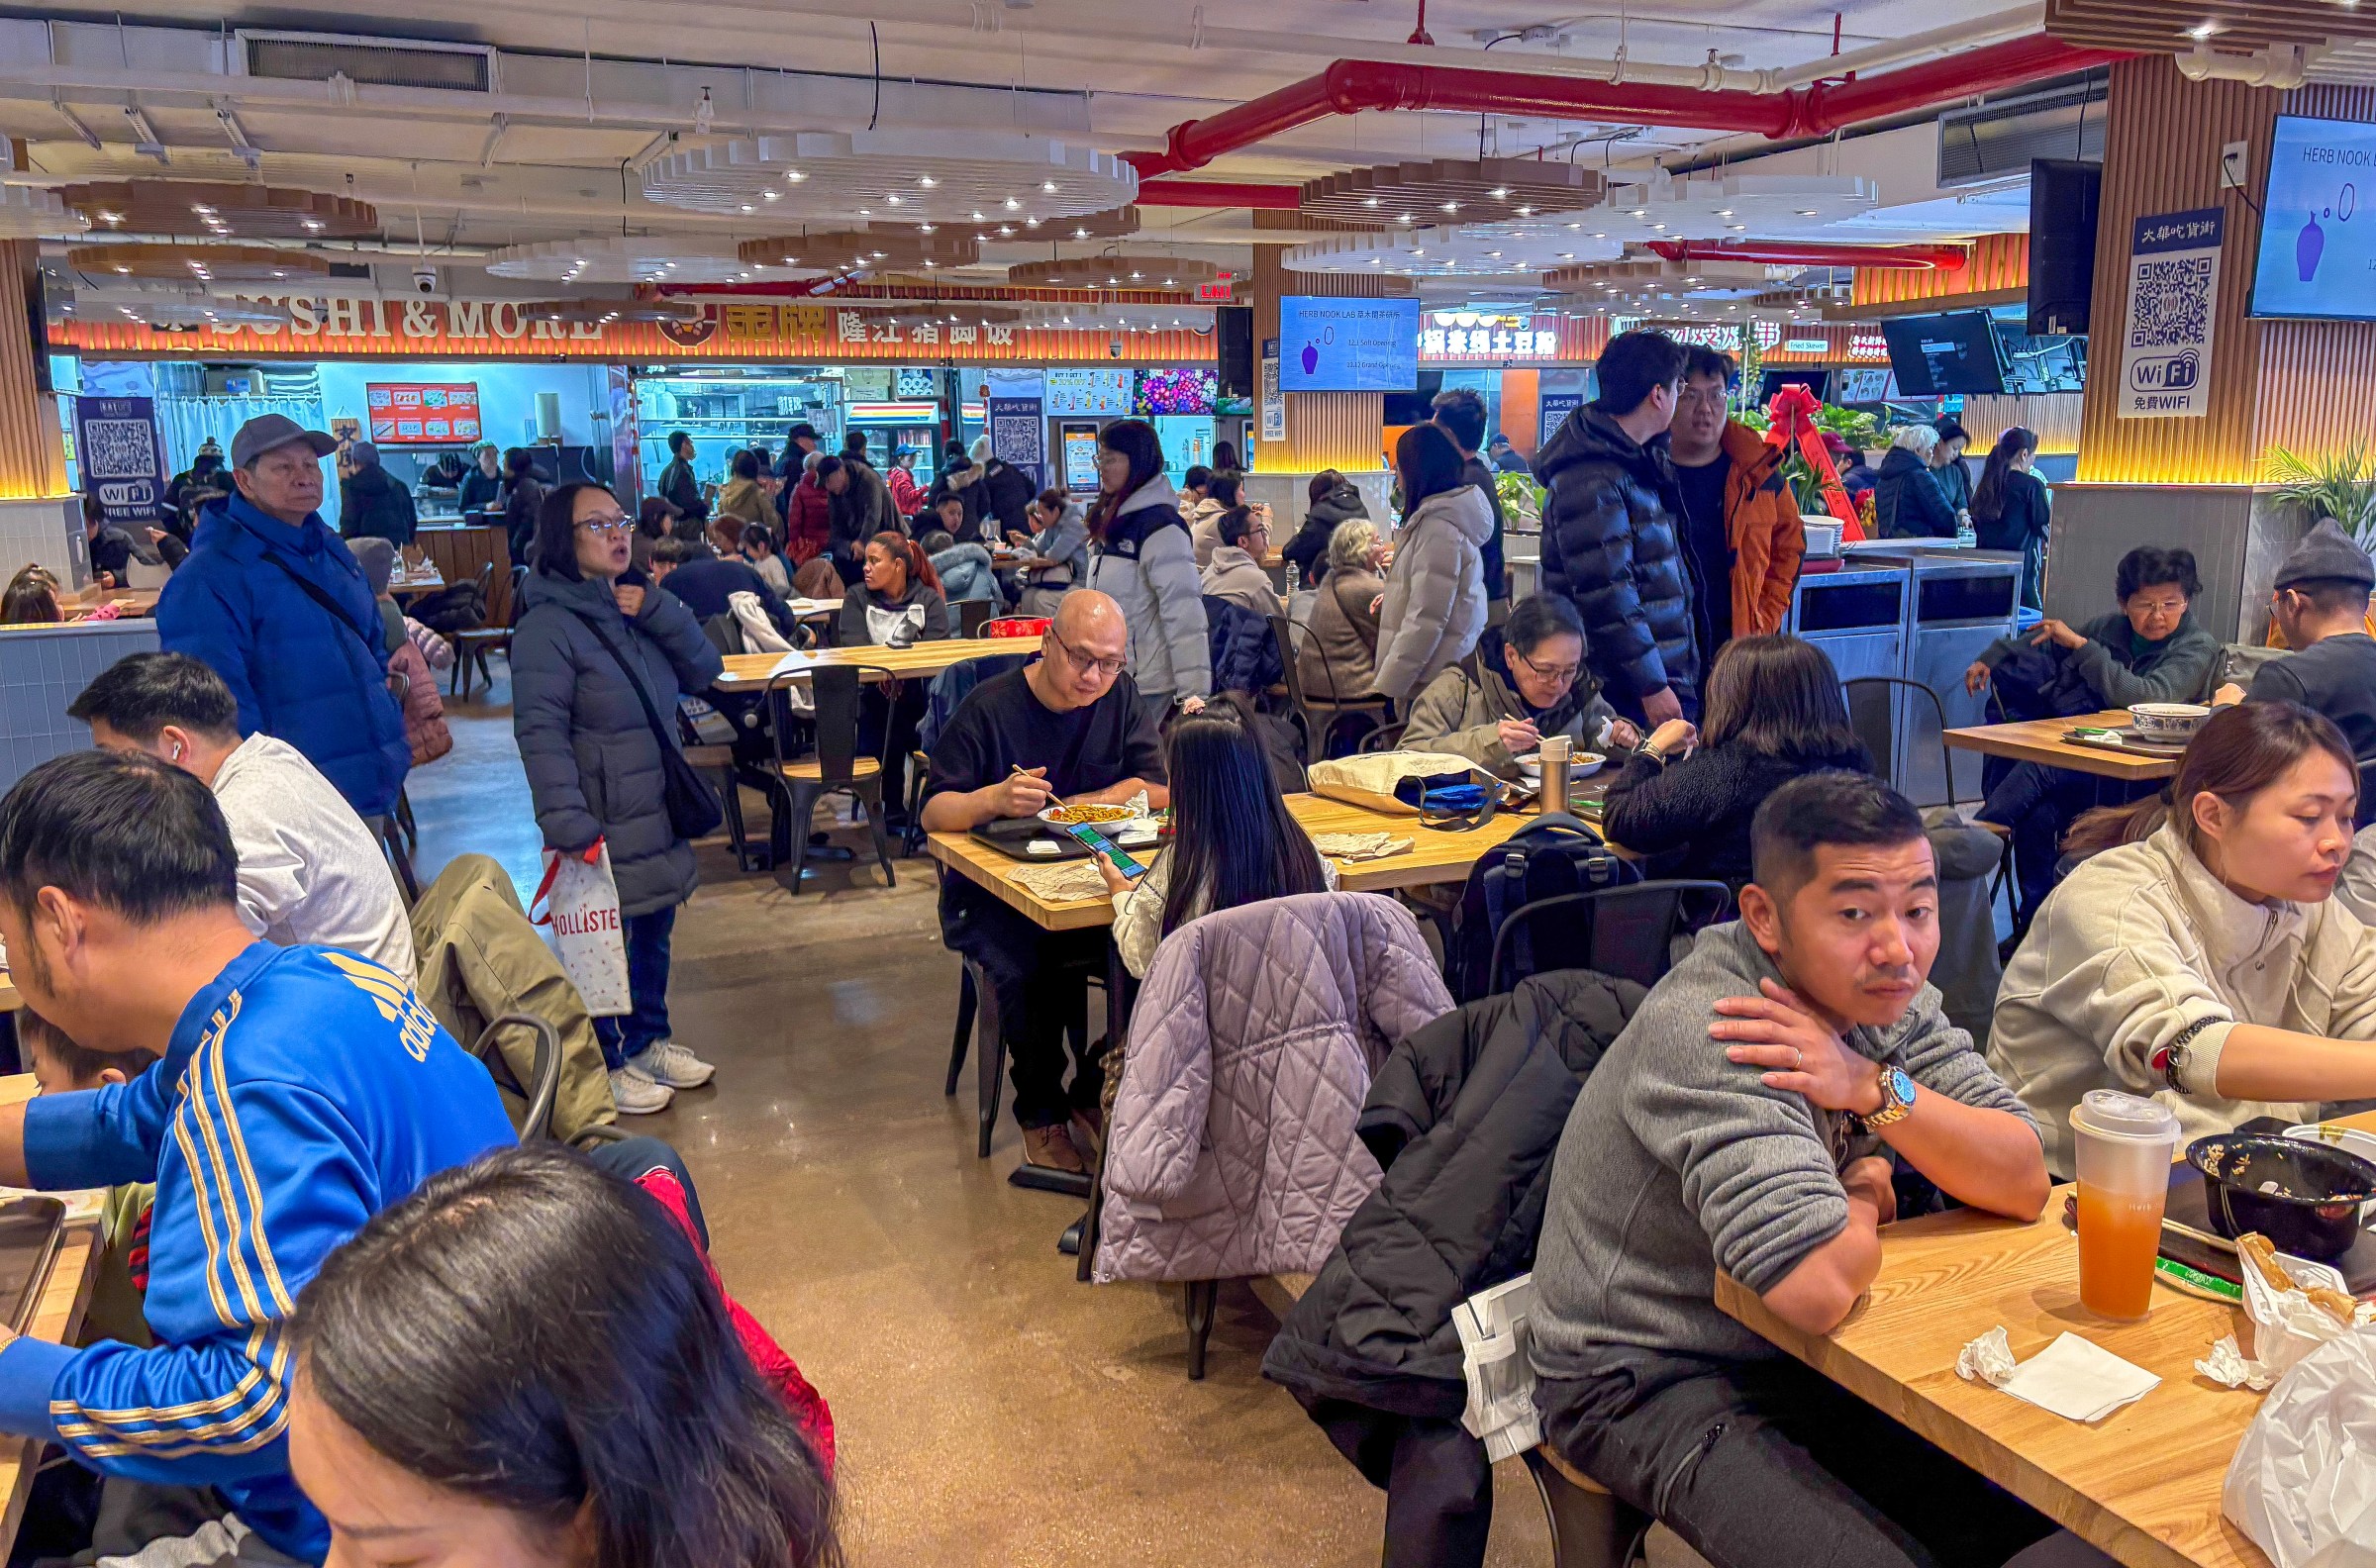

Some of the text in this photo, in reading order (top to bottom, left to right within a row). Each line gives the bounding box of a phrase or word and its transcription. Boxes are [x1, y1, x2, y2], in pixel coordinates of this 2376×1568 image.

[2303, 147, 2334, 163] HERB
[2337, 148, 2371, 166] NOOK
[402, 299, 439, 338] &
[727, 304, 829, 343] 金牌
[2137, 360, 2191, 384] WiFi
